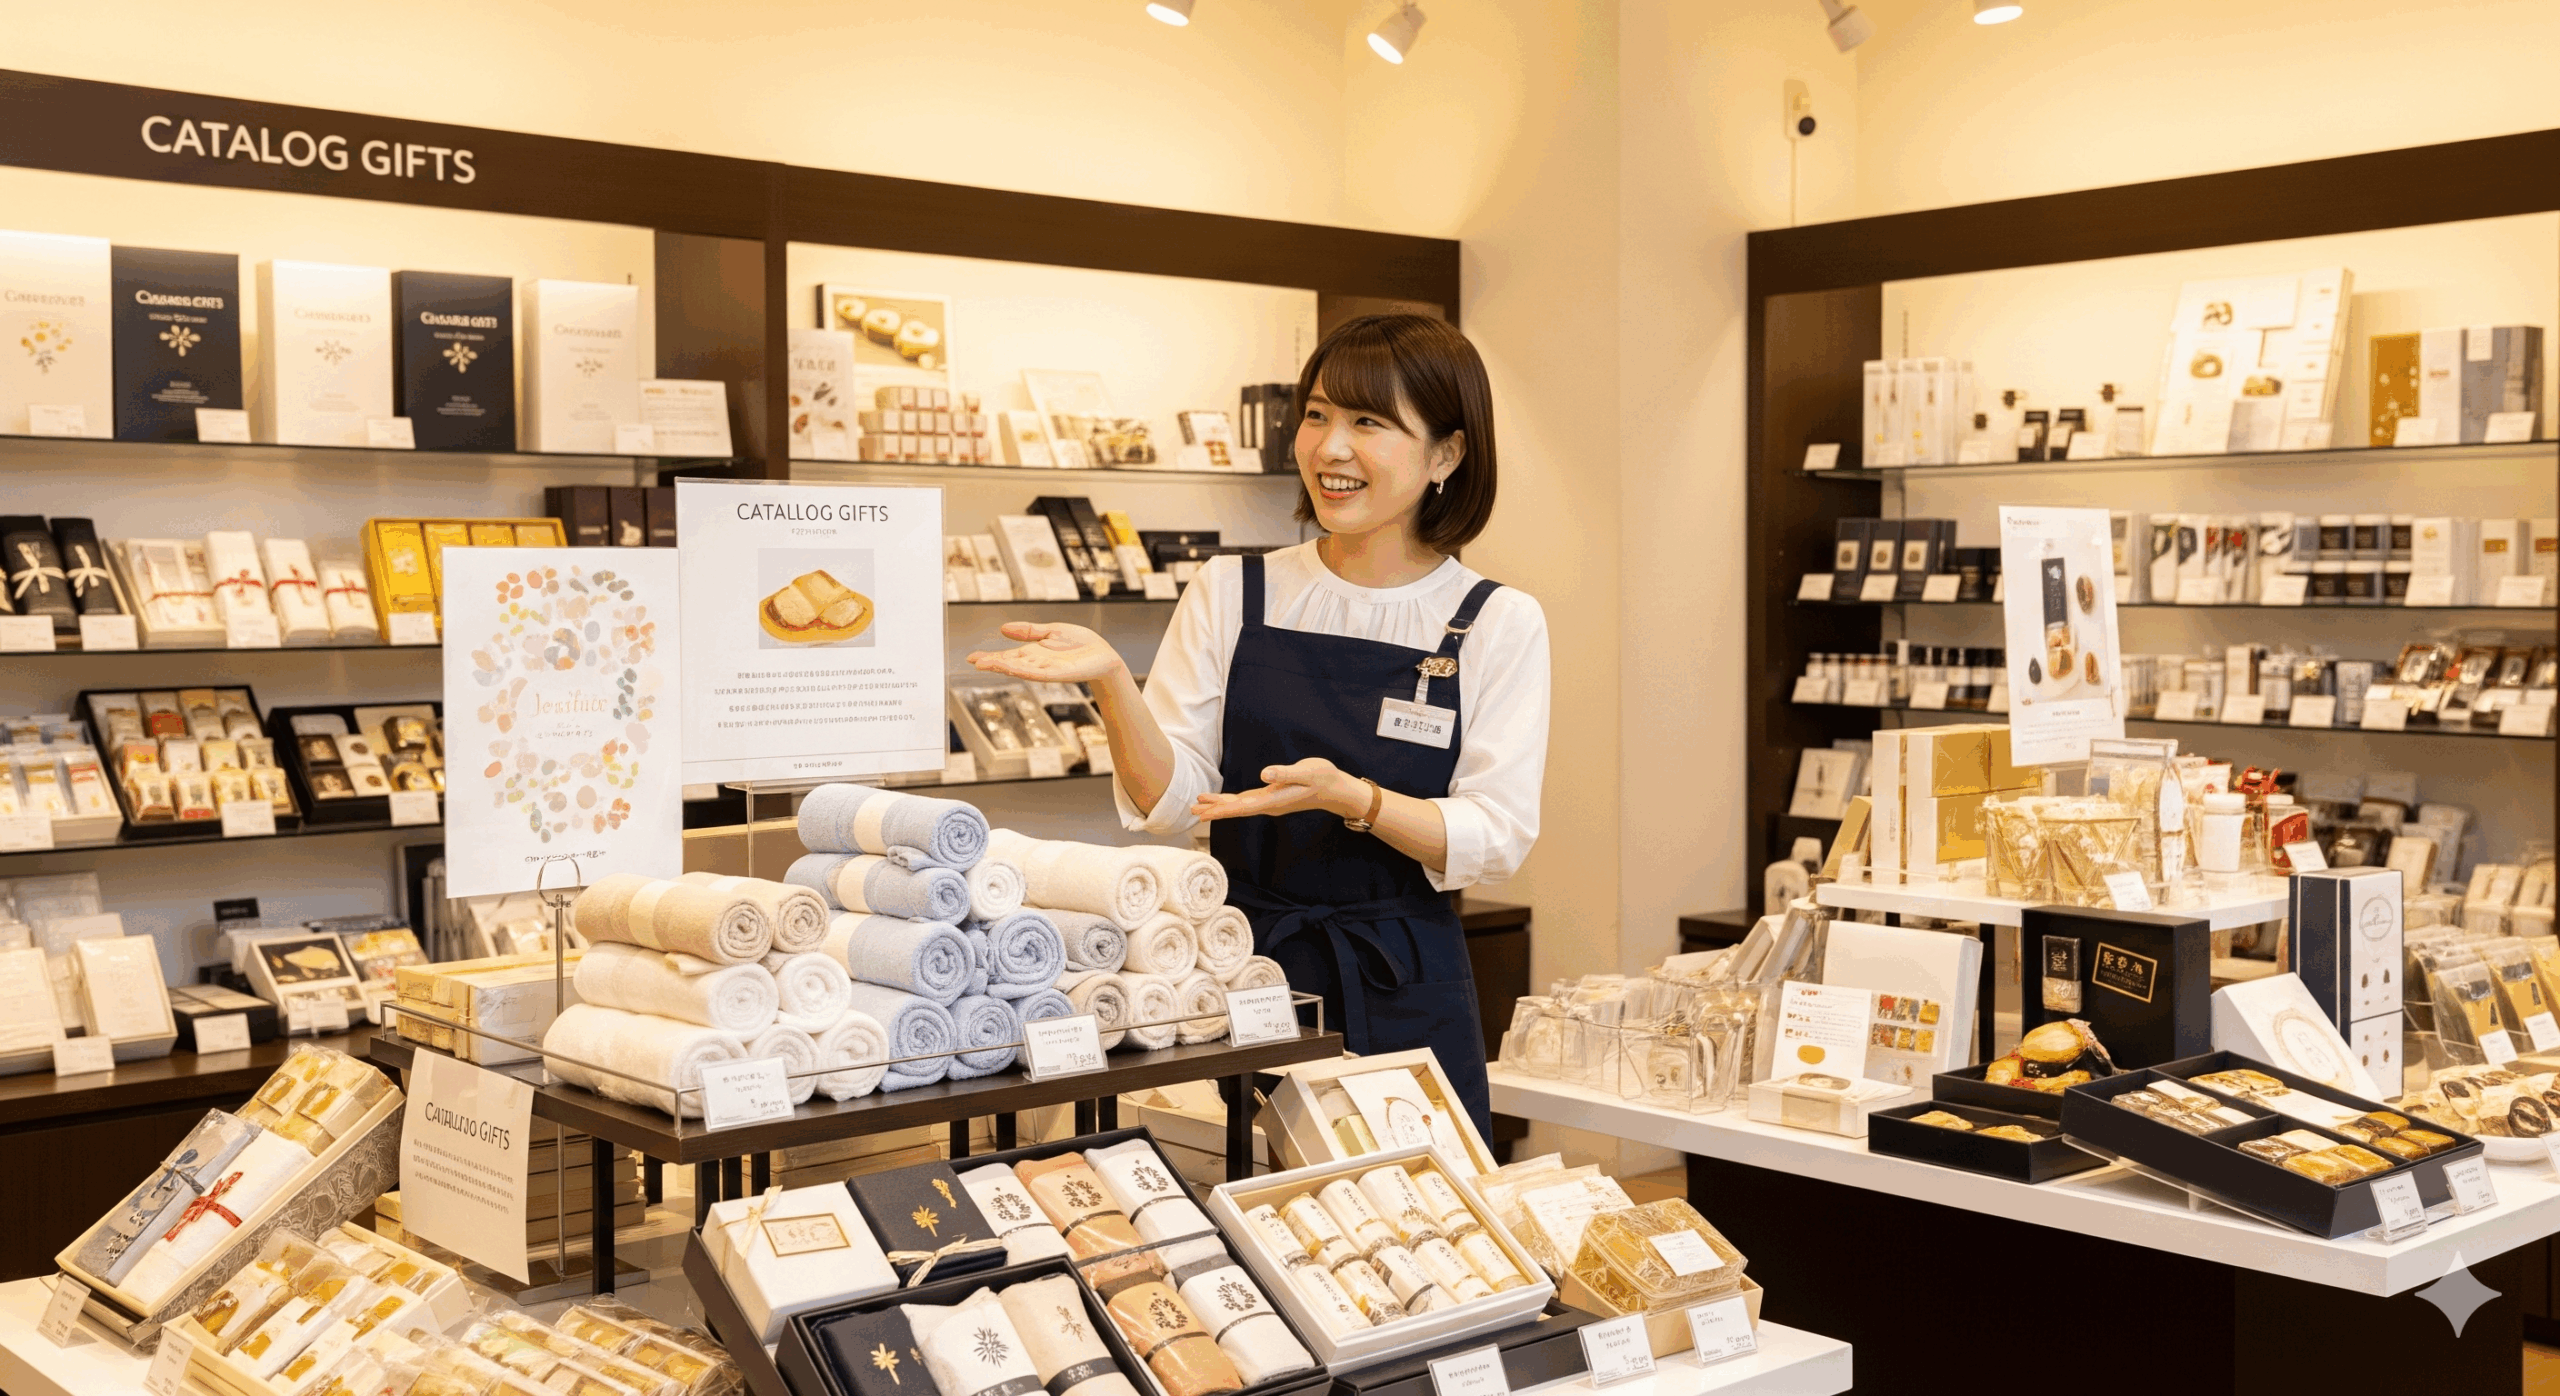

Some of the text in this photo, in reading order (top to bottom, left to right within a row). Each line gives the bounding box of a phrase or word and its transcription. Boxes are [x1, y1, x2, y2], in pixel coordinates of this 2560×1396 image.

[141, 115, 476, 184] CATALOG GIFTS
[737, 503, 889, 522] CATALLOG GIFTS
[479, 1121, 510, 1151] GIFTS
